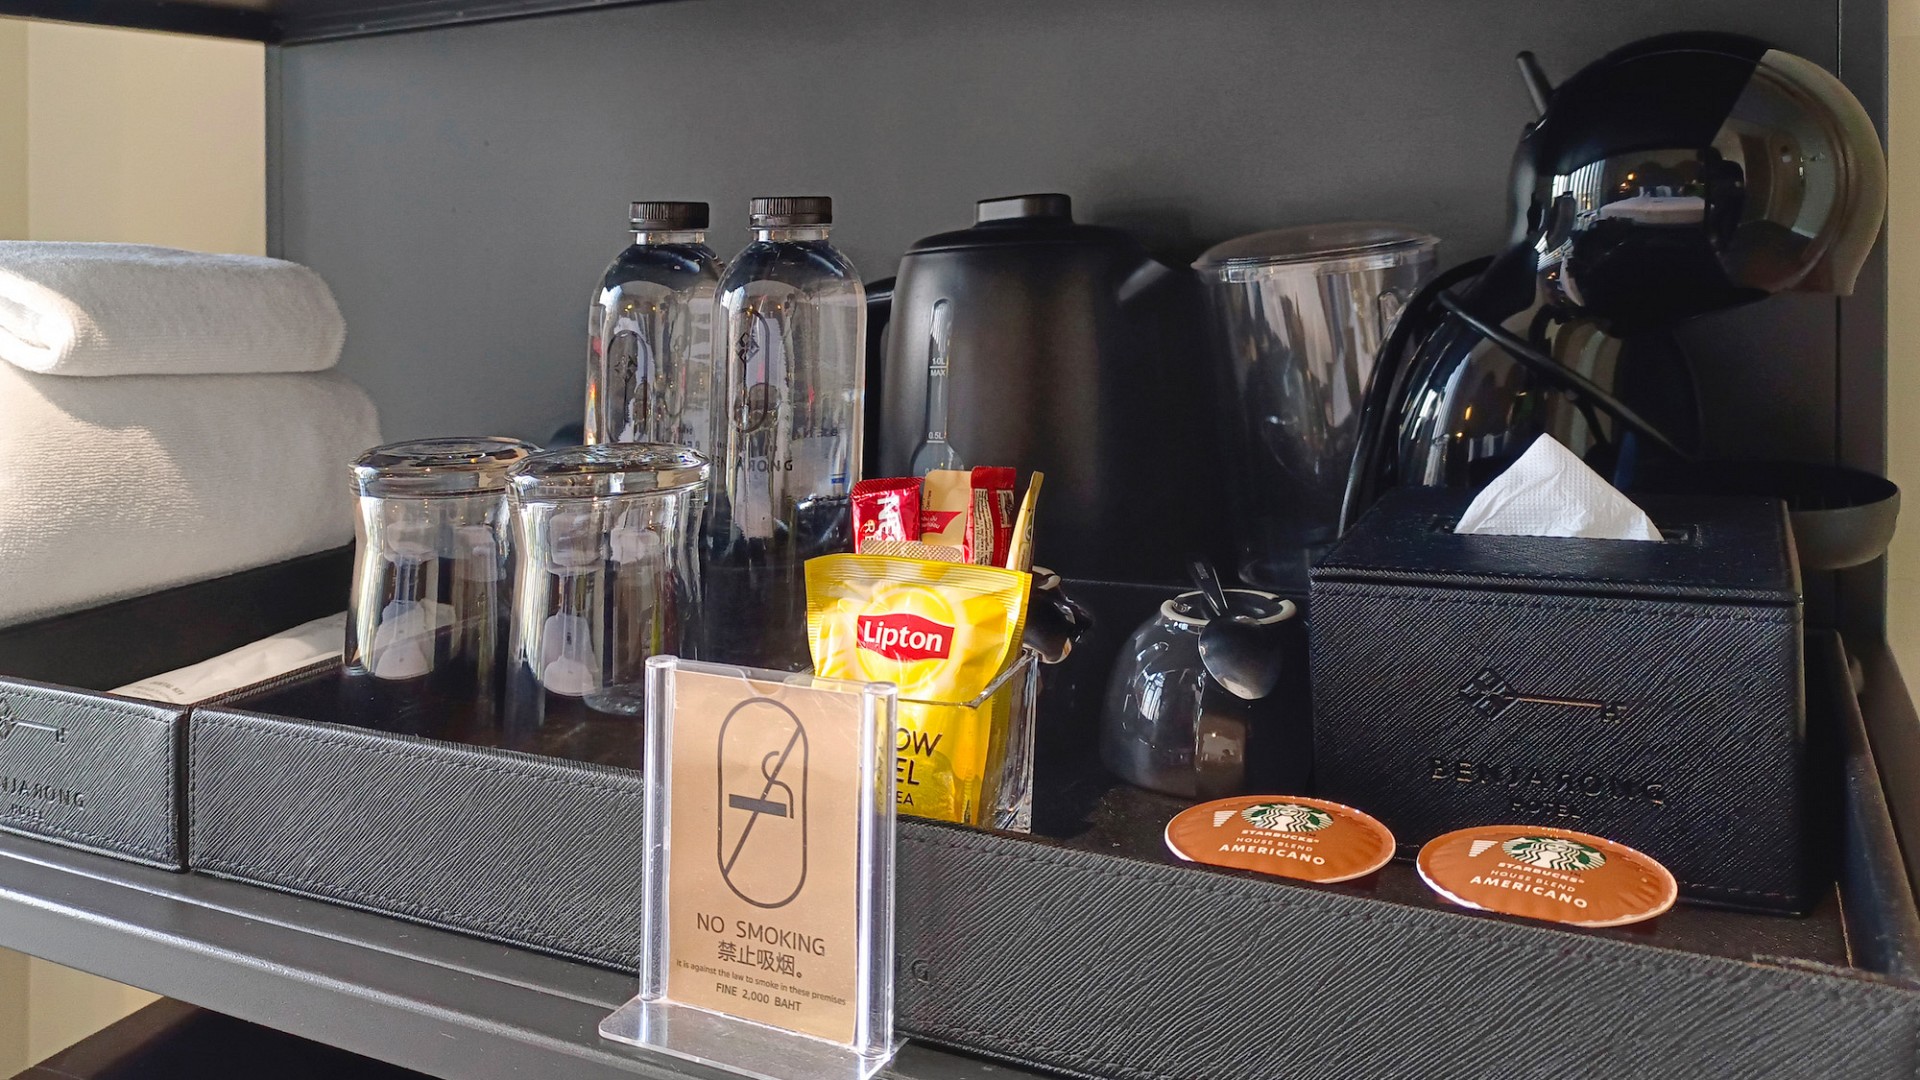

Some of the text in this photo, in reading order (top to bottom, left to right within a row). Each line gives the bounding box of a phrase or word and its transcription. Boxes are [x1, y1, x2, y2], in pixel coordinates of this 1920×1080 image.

[930, 369, 946, 377] MAX
[928, 431, 943, 440] 0.5L
[863, 620, 943, 652] Lipton
[1218, 843, 1326, 866] AMERICANO
[1236, 836, 1313, 852] HOUSE BLEND
[1469, 875, 1588, 909] AMERICANO
[1490, 869, 1576, 893] HOUSE BLEND
[697, 912, 826, 957] NO SMOKING
[690, 963, 717, 975] against
[718, 968, 731, 978] the
[732, 971, 744, 981] law
[745, 975, 753, 984] to
[755, 978, 780, 990] smoke
[780, 982, 788, 992] in
[789, 985, 810, 997] these
[811, 991, 846, 1006] premises
[716, 982, 802, 1012] FINE 2,000 BAHT
